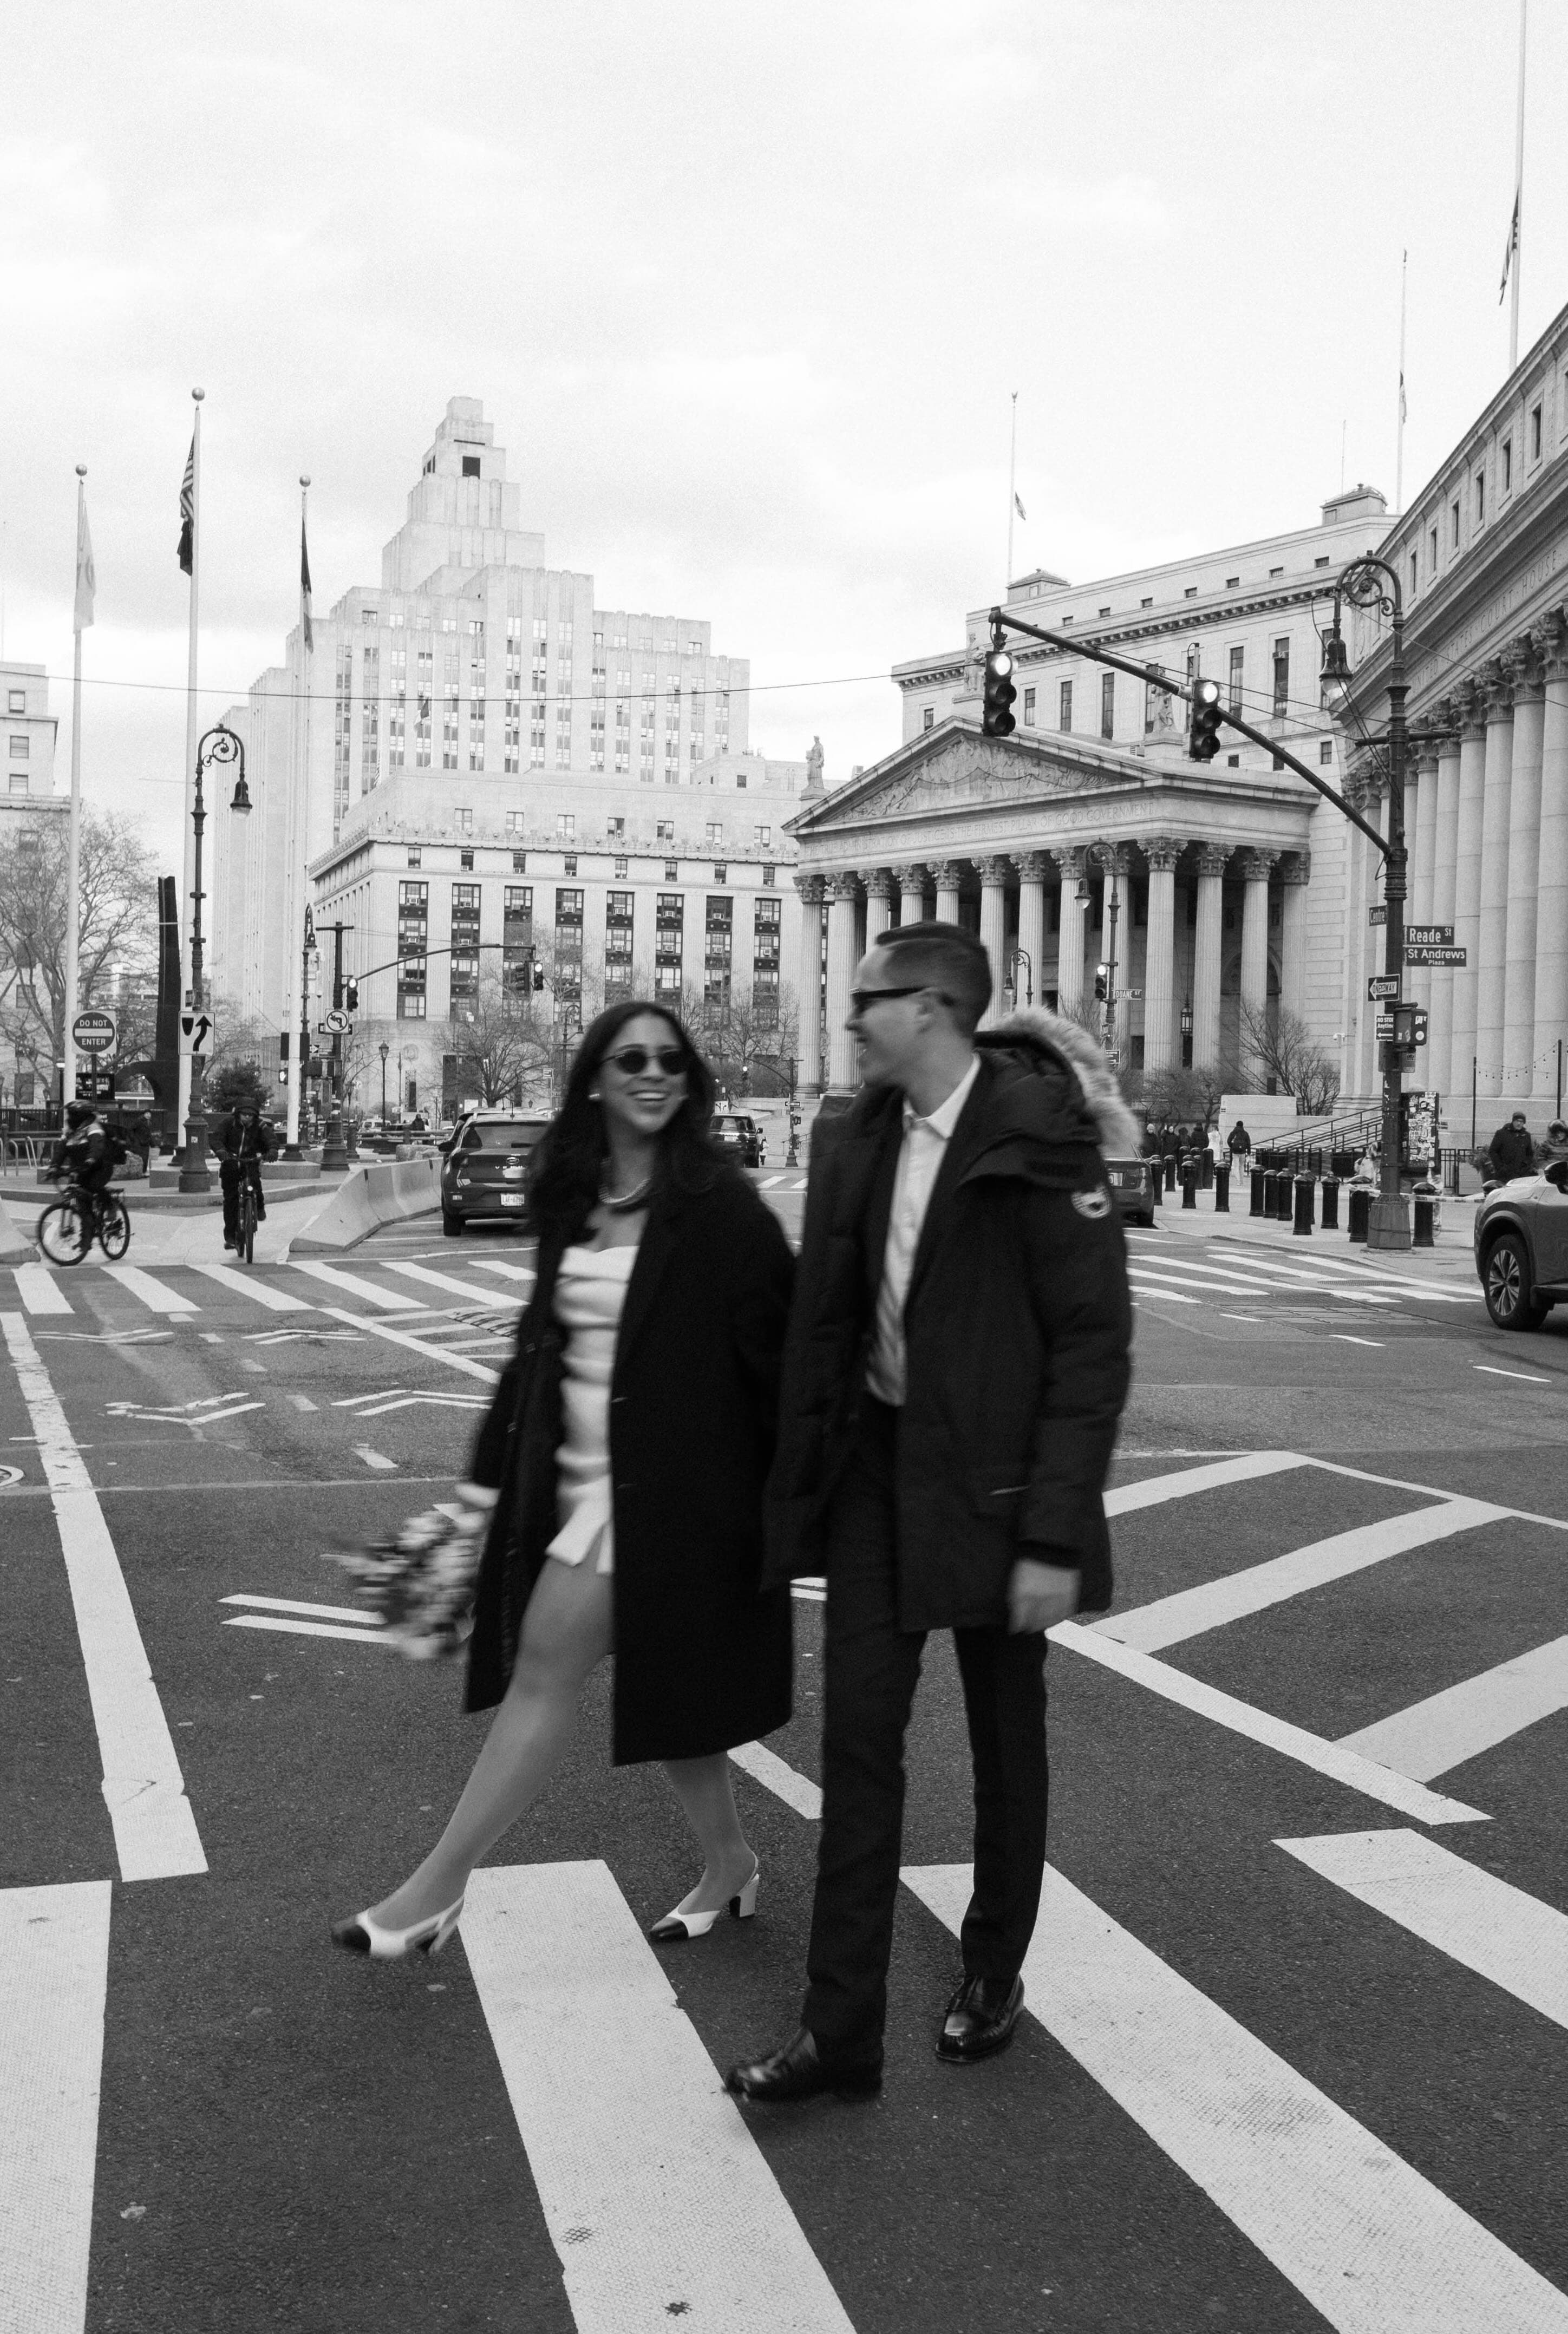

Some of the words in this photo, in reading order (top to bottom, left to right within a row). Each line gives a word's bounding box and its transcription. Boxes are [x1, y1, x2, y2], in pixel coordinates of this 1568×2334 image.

[1446, 626, 1472, 664] STATES
[1481, 589, 1513, 632] COURT
[1522, 550, 1556, 597] HOUSE
[974, 821, 1009, 835] FIRMEST
[1011, 816, 1037, 831] PILLAR
[1040, 815, 1053, 828] OF
[1055, 811, 1083, 826] GOOD
[1086, 802, 1153, 822] GOVERNMENT
[1370, 908, 1385, 923] Centre
[1409, 928, 1441, 943] Reade
[1445, 927, 1452, 936] St
[1408, 949, 1418, 958] St
[1421, 949, 1465, 959] Andrews
